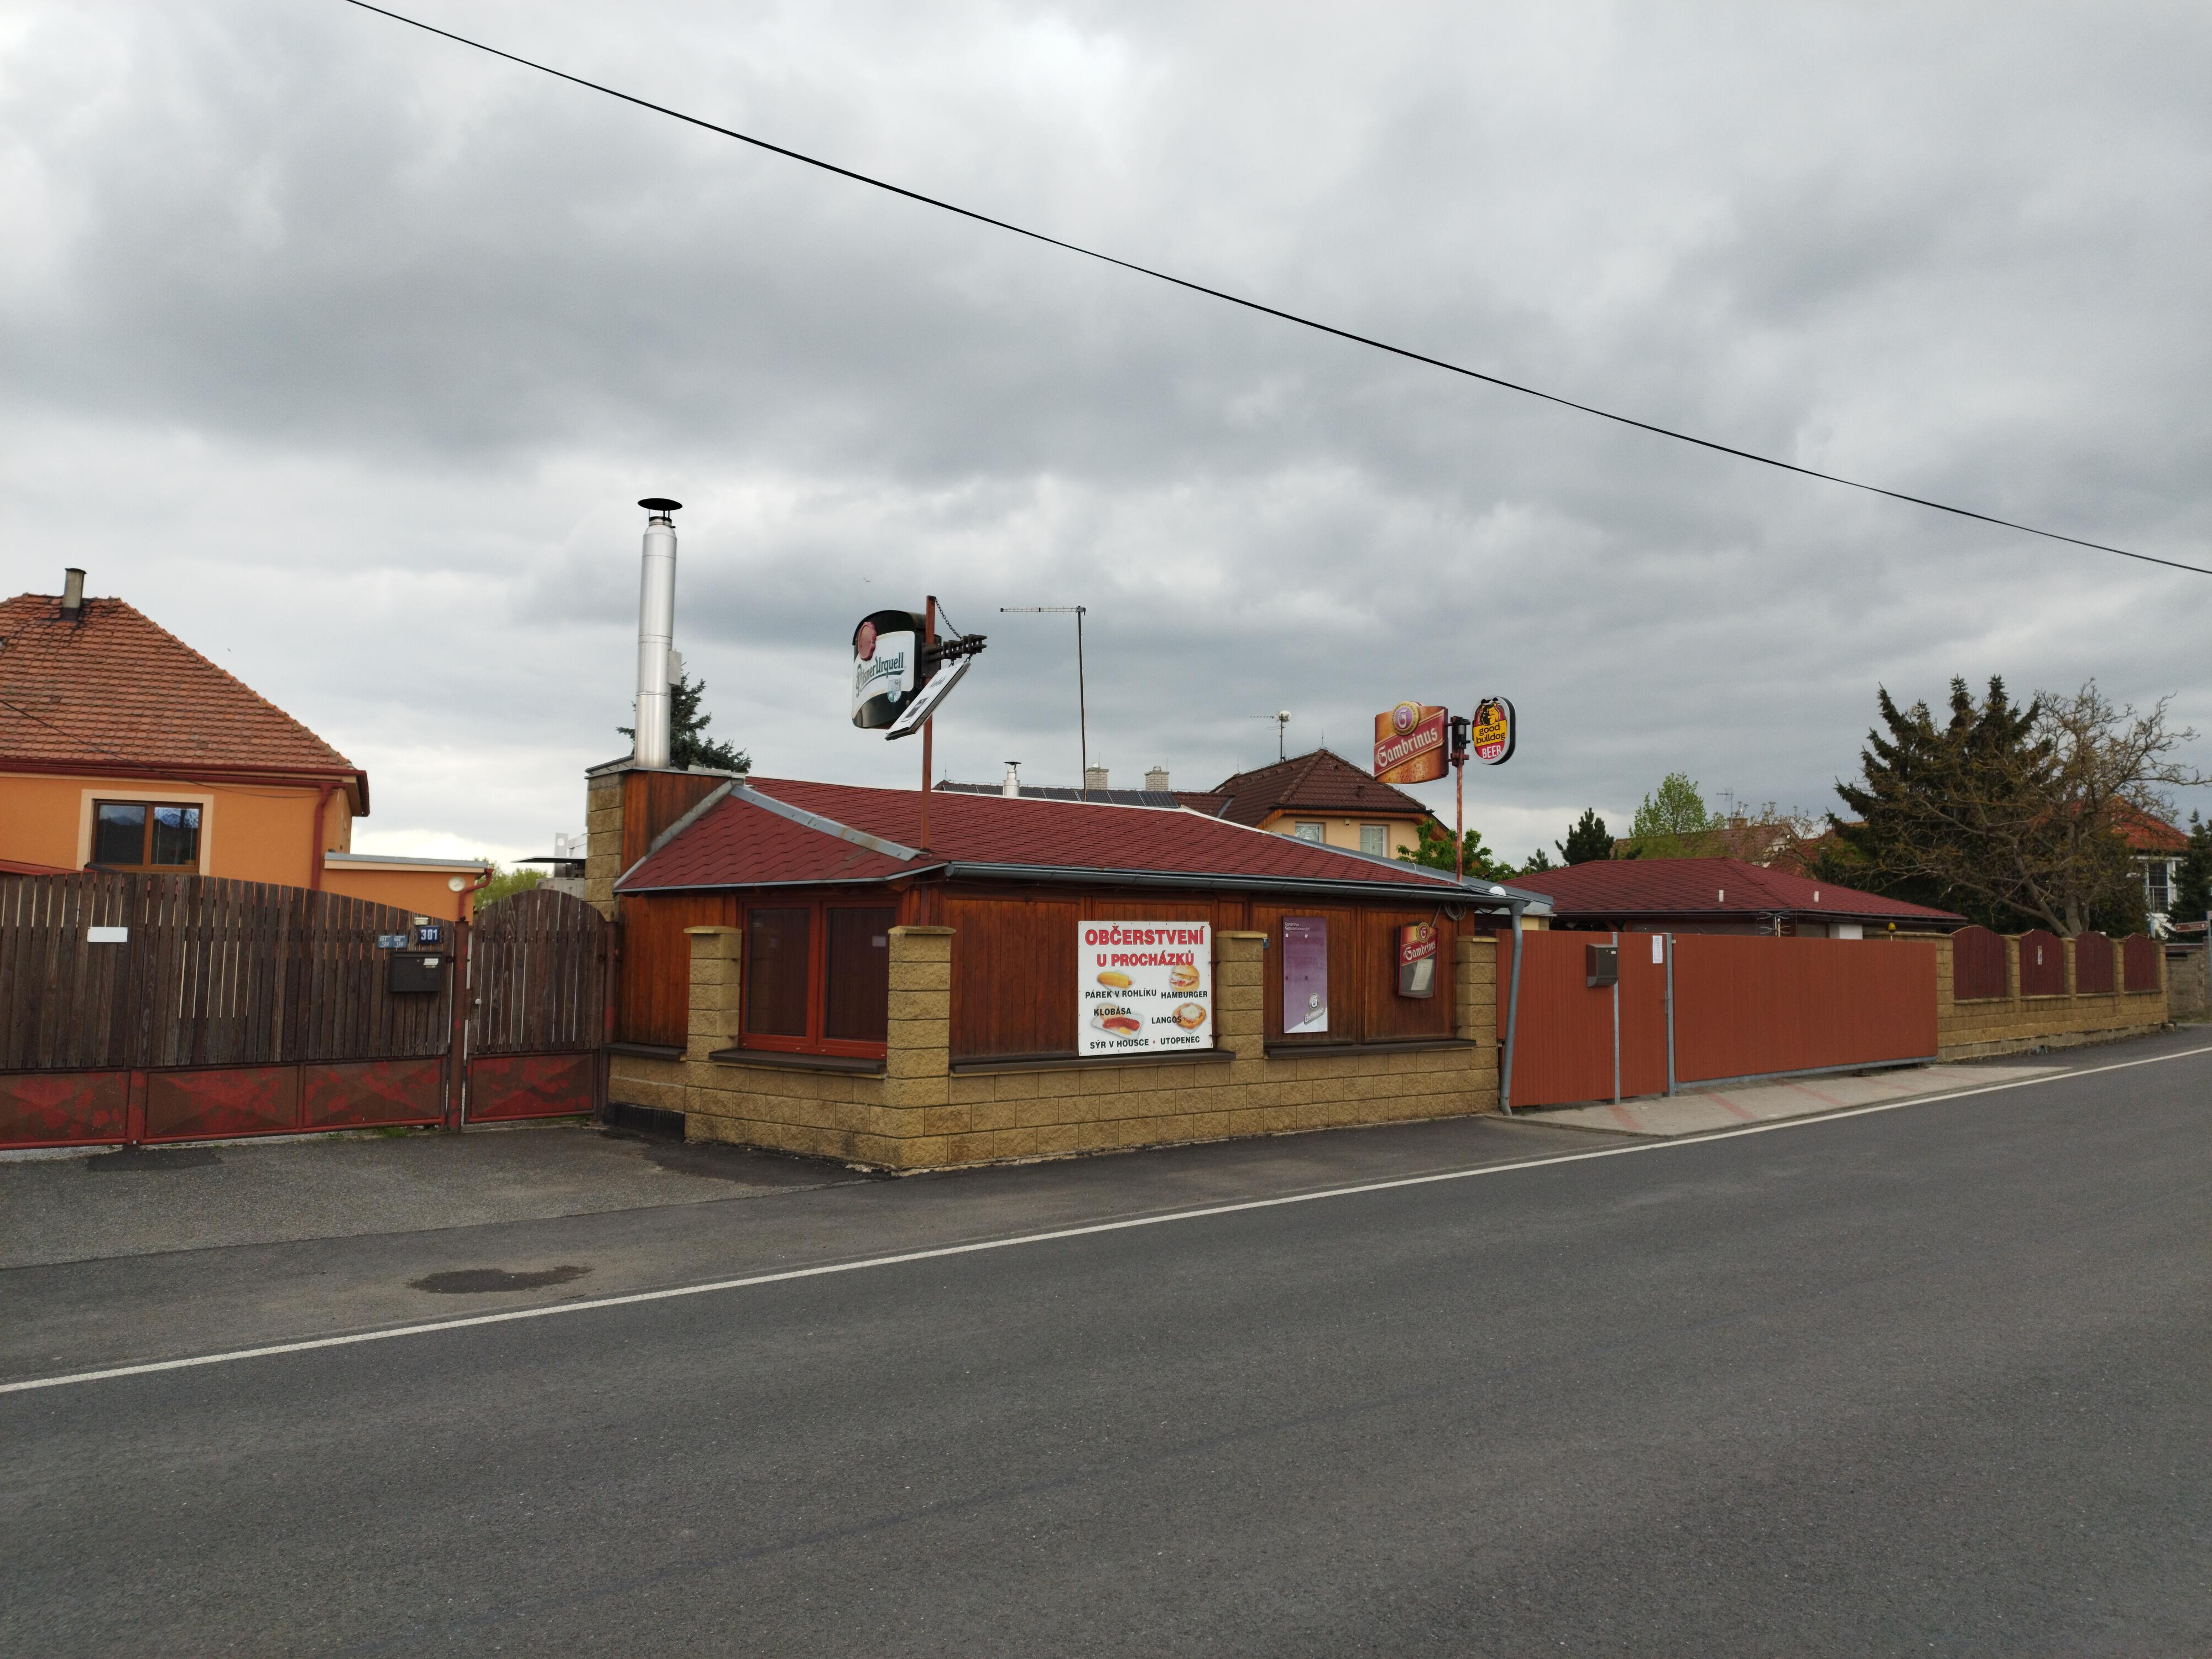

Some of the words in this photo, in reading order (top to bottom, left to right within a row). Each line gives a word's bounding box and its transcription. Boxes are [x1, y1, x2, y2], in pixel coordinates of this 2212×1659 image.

[856, 664, 876, 697] Pilsner
[875, 653, 904, 679] Urquell
[1479, 722, 1500, 736] good
[1475, 732, 1505, 744] bulldog
[1375, 728, 1438, 768] Gambrinus
[1481, 745, 1501, 759] BEER
[421, 928, 437, 940] 301
[1084, 925, 1205, 946] OBČERSTVENÍ
[1403, 940, 1436, 961] Gambrinus
[1097, 954, 1107, 967] U
[1111, 950, 1194, 967] PROCHÁZKŮ
[1085, 989, 1112, 999] PÁREK
[1122, 988, 1157, 998] ROHLÍKU
[1093, 1006, 1131, 1016] KLOBÁSA
[1151, 1016, 1182, 1024] LANGOŠ
[1090, 1040, 1106, 1049] SÝR
[1117, 1039, 1149, 1047] HOUSCE
[1160, 1036, 1200, 1045] UTOPENEC
